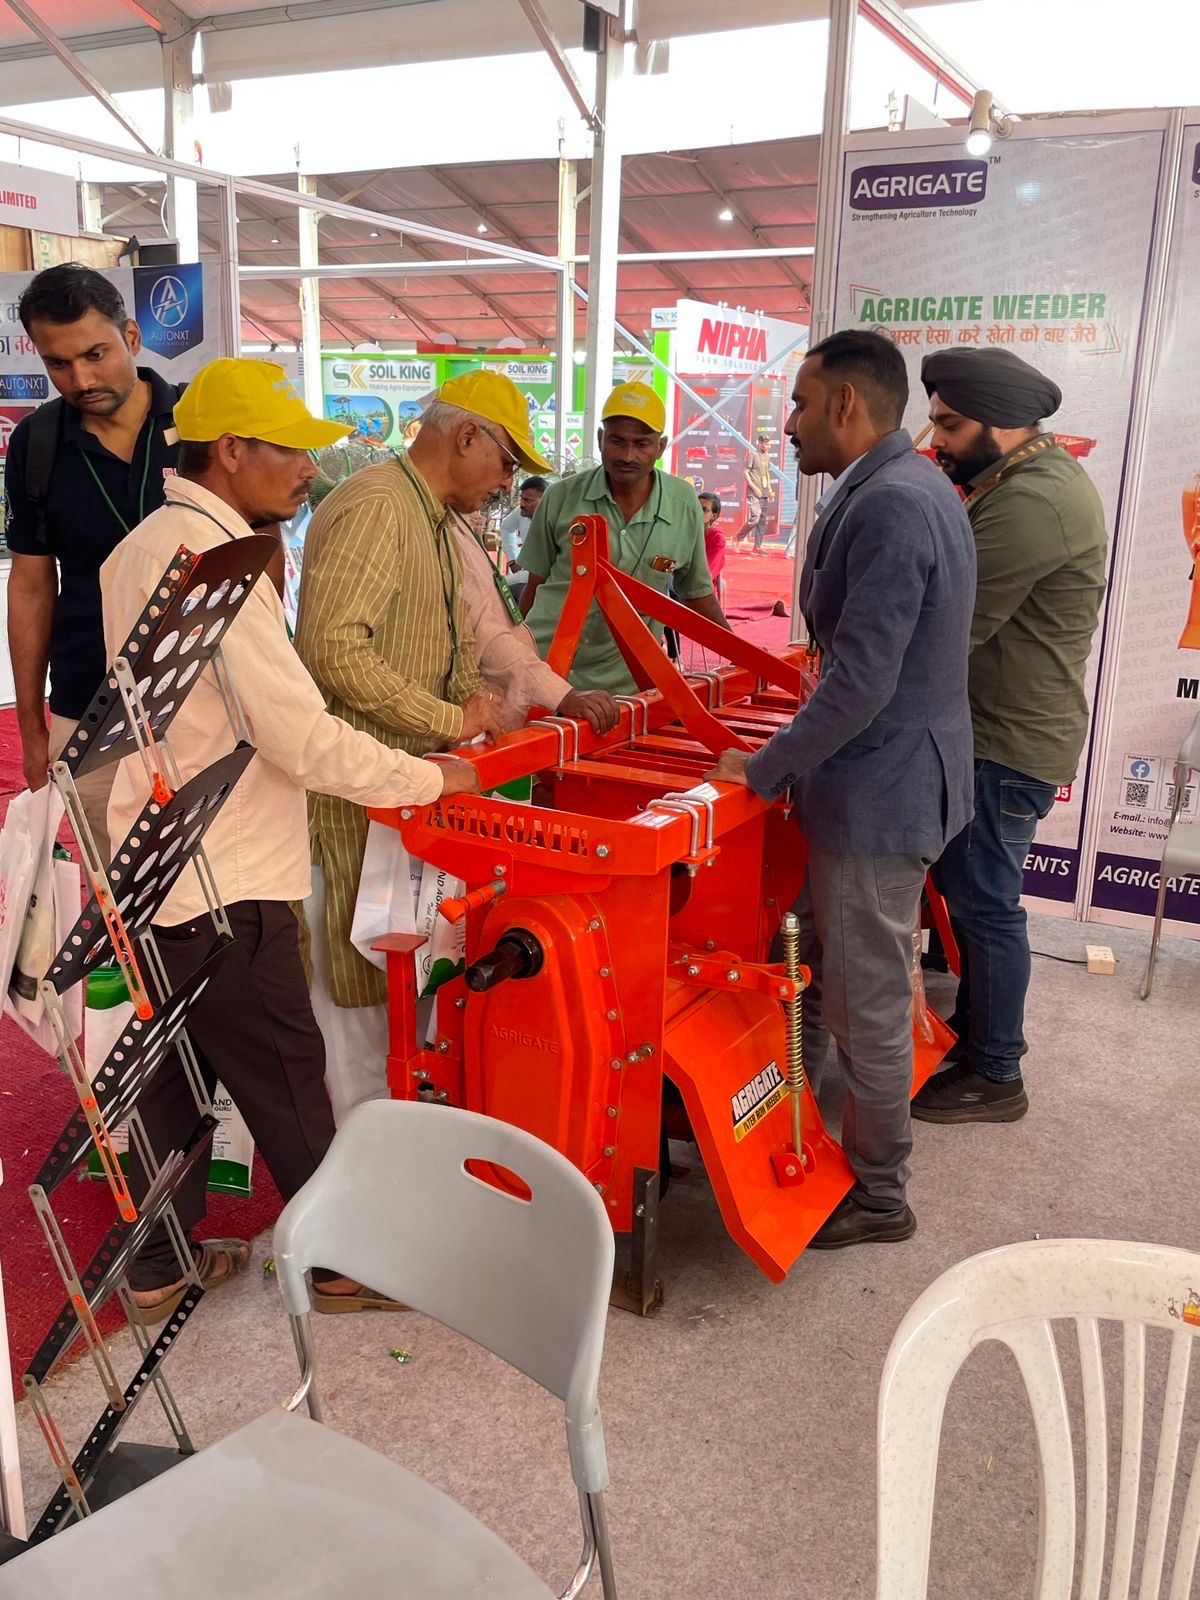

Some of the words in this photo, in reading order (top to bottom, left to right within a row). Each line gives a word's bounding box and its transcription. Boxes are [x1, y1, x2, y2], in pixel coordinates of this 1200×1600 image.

[853, 171, 984, 199] AGRIGATE
[0, 190, 37, 210] LIMITED
[851, 211, 897, 222] Strengthening
[899, 210, 936, 221] Agriculture
[939, 208, 977, 218] Technology
[860, 295, 983, 322] AGRIGATE
[992, 293, 1106, 320] WEEDER
[151, 330, 190, 342] AUTONXT
[697, 318, 767, 363] NIPHA
[369, 364, 397, 379] SOIL
[399, 365, 431, 380] KING
[507, 364, 526, 374] SOIL
[528, 364, 548, 374] KING
[426, 802, 589, 857] AGRIGATE
[1110, 825, 1147, 838] Website:
[491, 1024, 560, 1056] AGRIGATE
[731, 1061, 781, 1121] AGRIGATE
